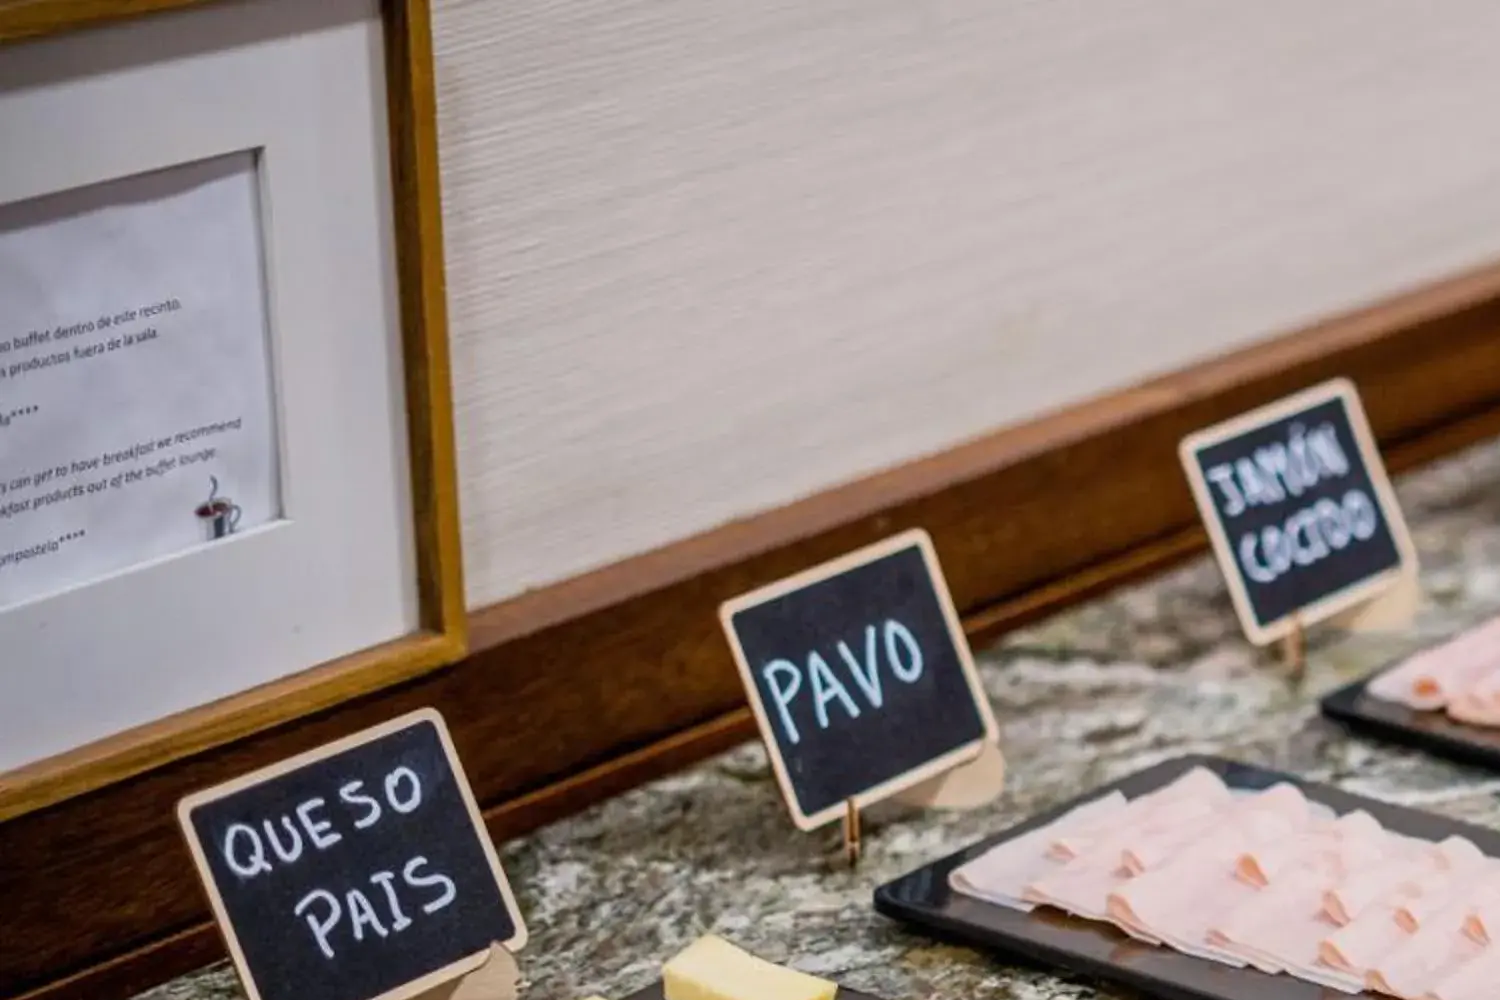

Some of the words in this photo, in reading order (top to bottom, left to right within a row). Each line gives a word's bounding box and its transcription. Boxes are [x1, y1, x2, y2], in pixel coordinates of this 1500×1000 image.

[9, 352, 70, 378] productos
[74, 343, 105, 359] fuera
[107, 338, 121, 352] de
[123, 334, 134, 346] la
[13, 327, 50, 351] buffet
[53, 320, 95, 340] dentro
[97, 315, 111, 330] de
[113, 310, 136, 326] este
[9, 476, 31, 491] can
[33, 468, 54, 488] get
[55, 465, 68, 477] to
[71, 457, 100, 474] have
[103, 440, 155, 467] breakfast
[157, 437, 172, 449] we
[174, 417, 242, 444] recommend
[33, 485, 85, 511] products
[86, 479, 107, 494] out
[109, 473, 122, 489] of
[125, 469, 142, 483] the
[145, 456, 176, 478] buffet
[763, 618, 924, 744] PAVO
[223, 765, 424, 877] QUESO
[294, 855, 458, 960] PAIS
